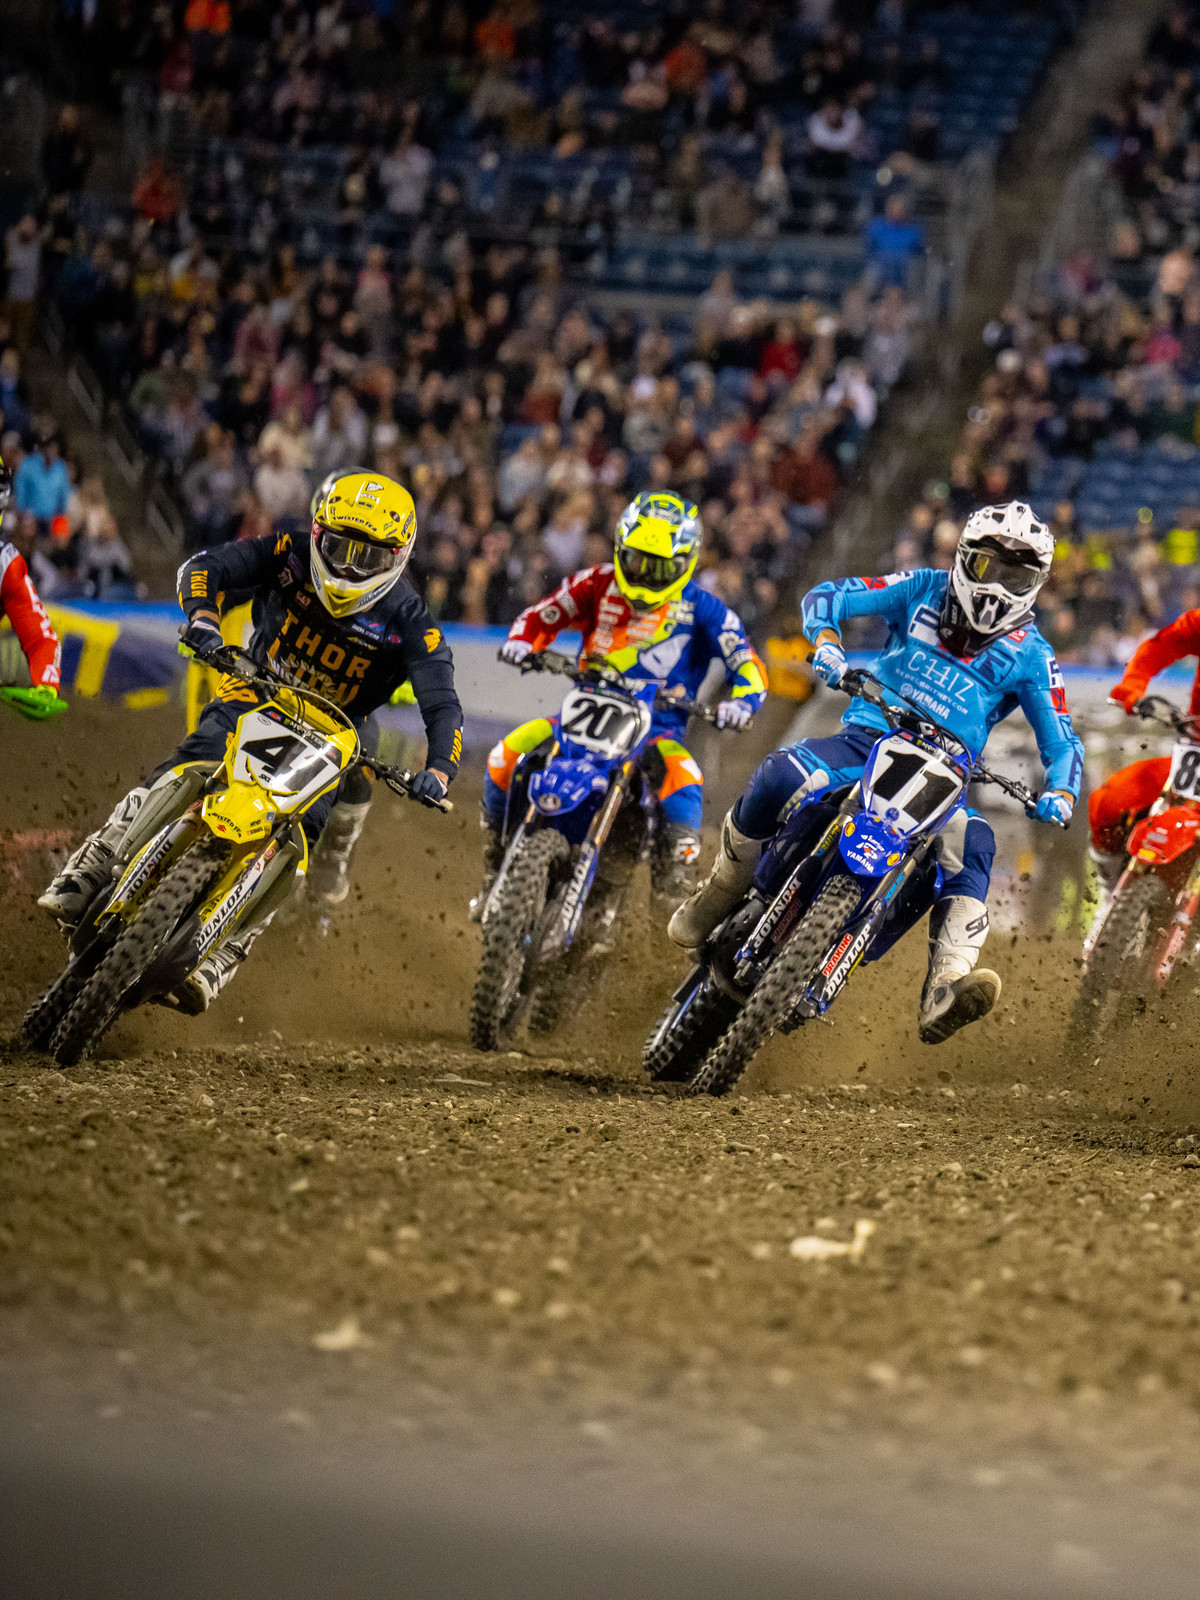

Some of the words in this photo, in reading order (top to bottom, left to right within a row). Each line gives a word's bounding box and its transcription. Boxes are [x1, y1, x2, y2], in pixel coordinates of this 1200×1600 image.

[190, 569, 208, 598] THOR
[281, 608, 372, 679] THOR
[912, 688, 951, 720] YAMAHA
[240, 735, 329, 793] 41
[873, 749, 959, 824] 11
[207, 811, 234, 829] TWISTED
[232, 825, 243, 838] TEA
[846, 849, 875, 873] YAMAHA
[196, 884, 243, 946] DUNLOP
[754, 877, 802, 948] DUNLOP
[824, 934, 852, 977] BRAKING
[825, 922, 871, 999] DUNLOP
